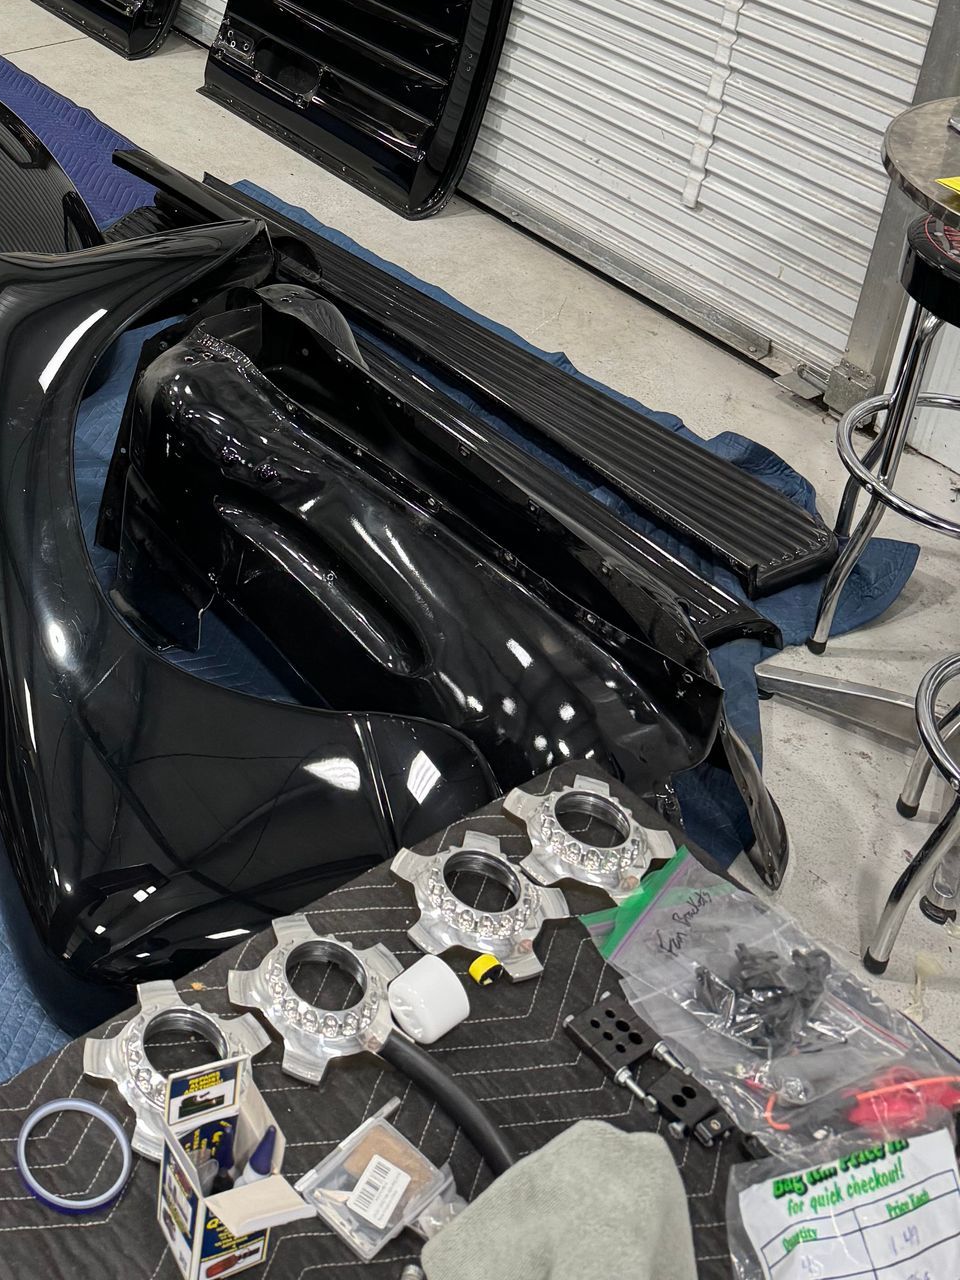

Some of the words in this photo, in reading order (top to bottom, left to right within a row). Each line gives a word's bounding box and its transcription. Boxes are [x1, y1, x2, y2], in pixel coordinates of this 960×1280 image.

[787, 1197, 805, 1217] for
[810, 1181, 845, 1215] quick
[847, 1156, 906, 1197] checkout!
[885, 1199, 911, 1219] Price
